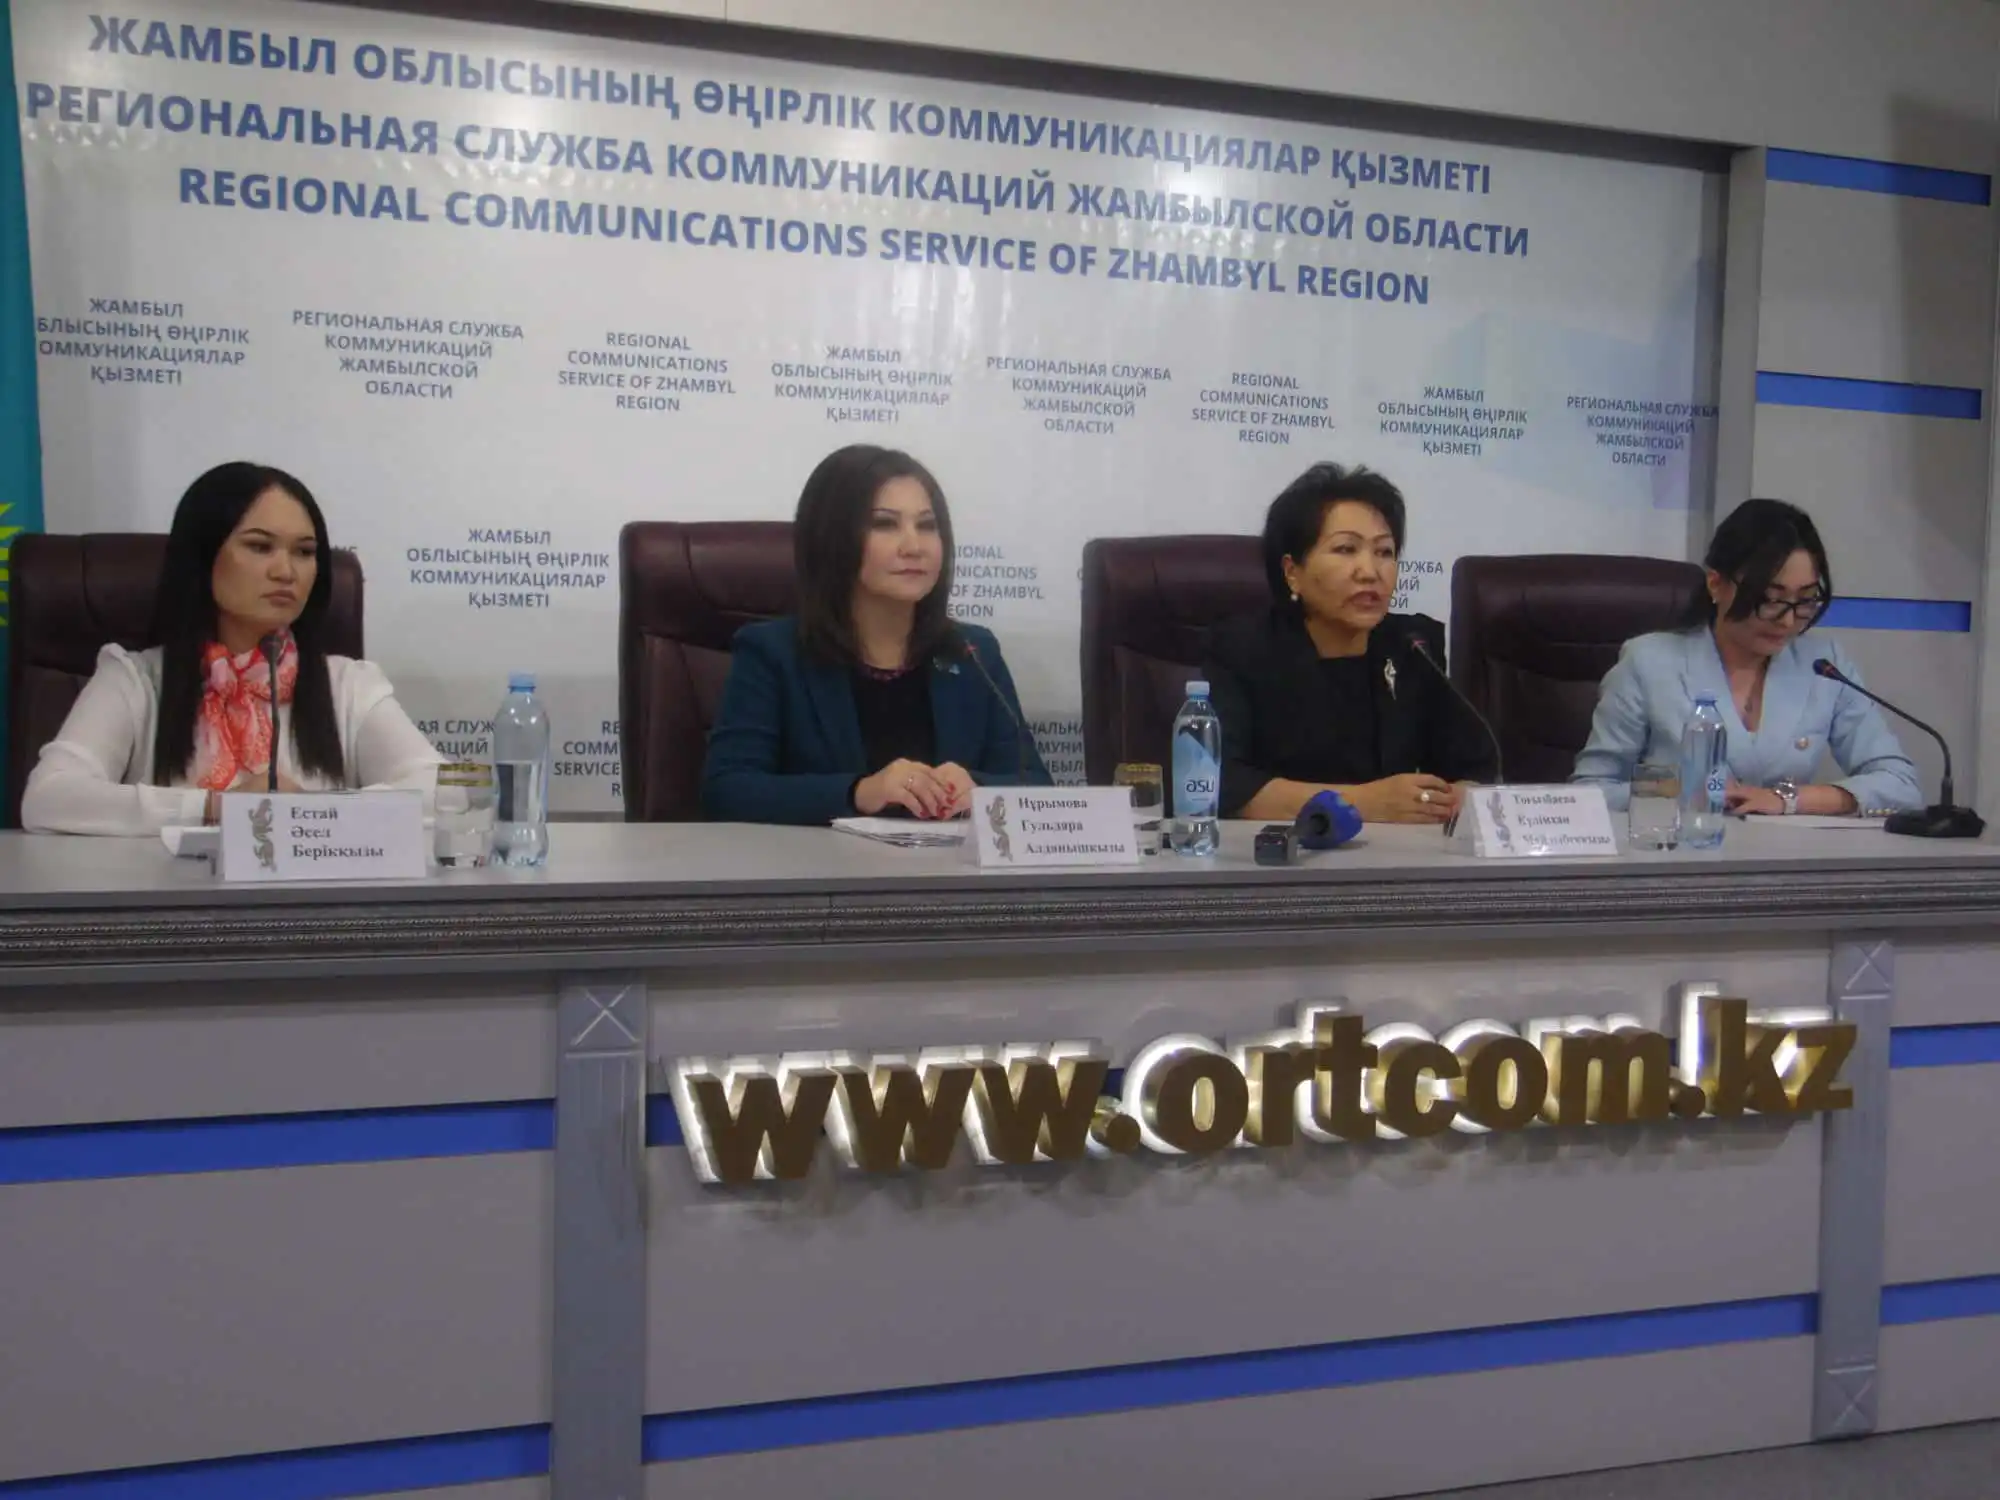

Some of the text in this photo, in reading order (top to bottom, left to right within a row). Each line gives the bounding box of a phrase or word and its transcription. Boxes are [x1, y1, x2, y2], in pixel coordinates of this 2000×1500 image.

[89, 14, 1491, 195] ЖАМБЫЛ ОБЛЫСЫНЫҢ ӨҢІРЛІК КОММУНИКАЦИЯЛАР ҚЫЗМЕТІ
[26, 82, 1530, 257] РЕГИОНАЛЬНАЯ СЛУЖБА КОММУНИКАЦИЙ ЖАМБЫЛСКОЙ ОБЛАСТИ
[179, 166, 1430, 305] REGIONAL COMMUNICATIONS SERVICE OF ZHAMBYL REGION
[89, 298, 184, 318] ЖАМБЫЛ
[37, 317, 250, 344] БЛЫСЫНЫҢ ӨҢІРЛІК
[292, 310, 524, 339] РЕГИОНАЛЬНАЯ СЛУЖБА
[325, 333, 493, 359] КОММУНИКАЦИЙ
[606, 332, 691, 351] REGIONAL
[39, 340, 246, 365] ОММУНИКАЦИЯЛАР
[567, 350, 728, 374] COMMUNICATIONS
[825, 345, 901, 364] ЖАМБЫЛ
[91, 366, 182, 386] ҚЫЗМЕТІ
[339, 357, 479, 379] ЖАМБЫЛСКОЙ
[771, 363, 953, 389] ОБЛЫСЫНЫҢ ӨҢІРЛІК
[986, 356, 1172, 381] РЕГИОНАЛЬНАЯ СЛУЖБА
[365, 380, 453, 399] ОБЛАСТИ
[558, 370, 736, 395] SERVICE OF ZHAMBYL
[1012, 377, 1146, 400] КОММУНИКАЦИЙ
[1231, 372, 1300, 390] REGIONAL
[615, 394, 681, 411] REGION
[774, 383, 950, 408] КОММУНИКАЦИЯЛАР
[1199, 389, 1329, 410] COMMUNICATIONS
[1423, 386, 1485, 403] ЖАМБЫЛ
[826, 406, 900, 425] ҚЫЗМЕТІ
[1023, 397, 1136, 417] ЖАМБЫЛСКОЙ
[1377, 402, 1528, 427] ОБЛЫСЫНЫҢ ӨҢІРЛІК
[1566, 395, 1720, 418] РЕГИОНАЛЬНАЯ СЛУЖБА
[1044, 417, 1114, 434] ОБЛАСТИ
[1191, 408, 1335, 431] SERVICE OF ZHAMBYL
[1586, 415, 1695, 435] КОММУНИКАЦИЙ
[1238, 428, 1290, 445] REGION
[1380, 420, 1524, 442] КОММУНИКАЦИЯЛАР
[1423, 440, 1482, 457] ҚЫЗМЕТІ
[1596, 432, 1685, 451] ЖАМБЫЛСКОЙ
[1612, 451, 1666, 466] ОБЛАСТИ
[468, 528, 551, 545] ЖАМБЫЛ
[407, 548, 609, 568] ОБЛЫСЫНЫҢ ӨҢІРЛІК
[957, 545, 1004, 559] IONAL
[956, 565, 1038, 580] NICATIONS
[1397, 561, 1444, 574] ЛУЖБА
[410, 569, 606, 588] КОММУНИКАЦИЯЛАР
[468, 591, 549, 608] ҚЫЗМЕТІ
[950, 584, 1045, 600] OF ZHAMBYL
[948, 604, 994, 617] EGION
[444, 720, 495, 735] СЛУЖ
[554, 762, 620, 776] SERVICE
[678, 988, 1854, 1183] www.ortcom.kz
